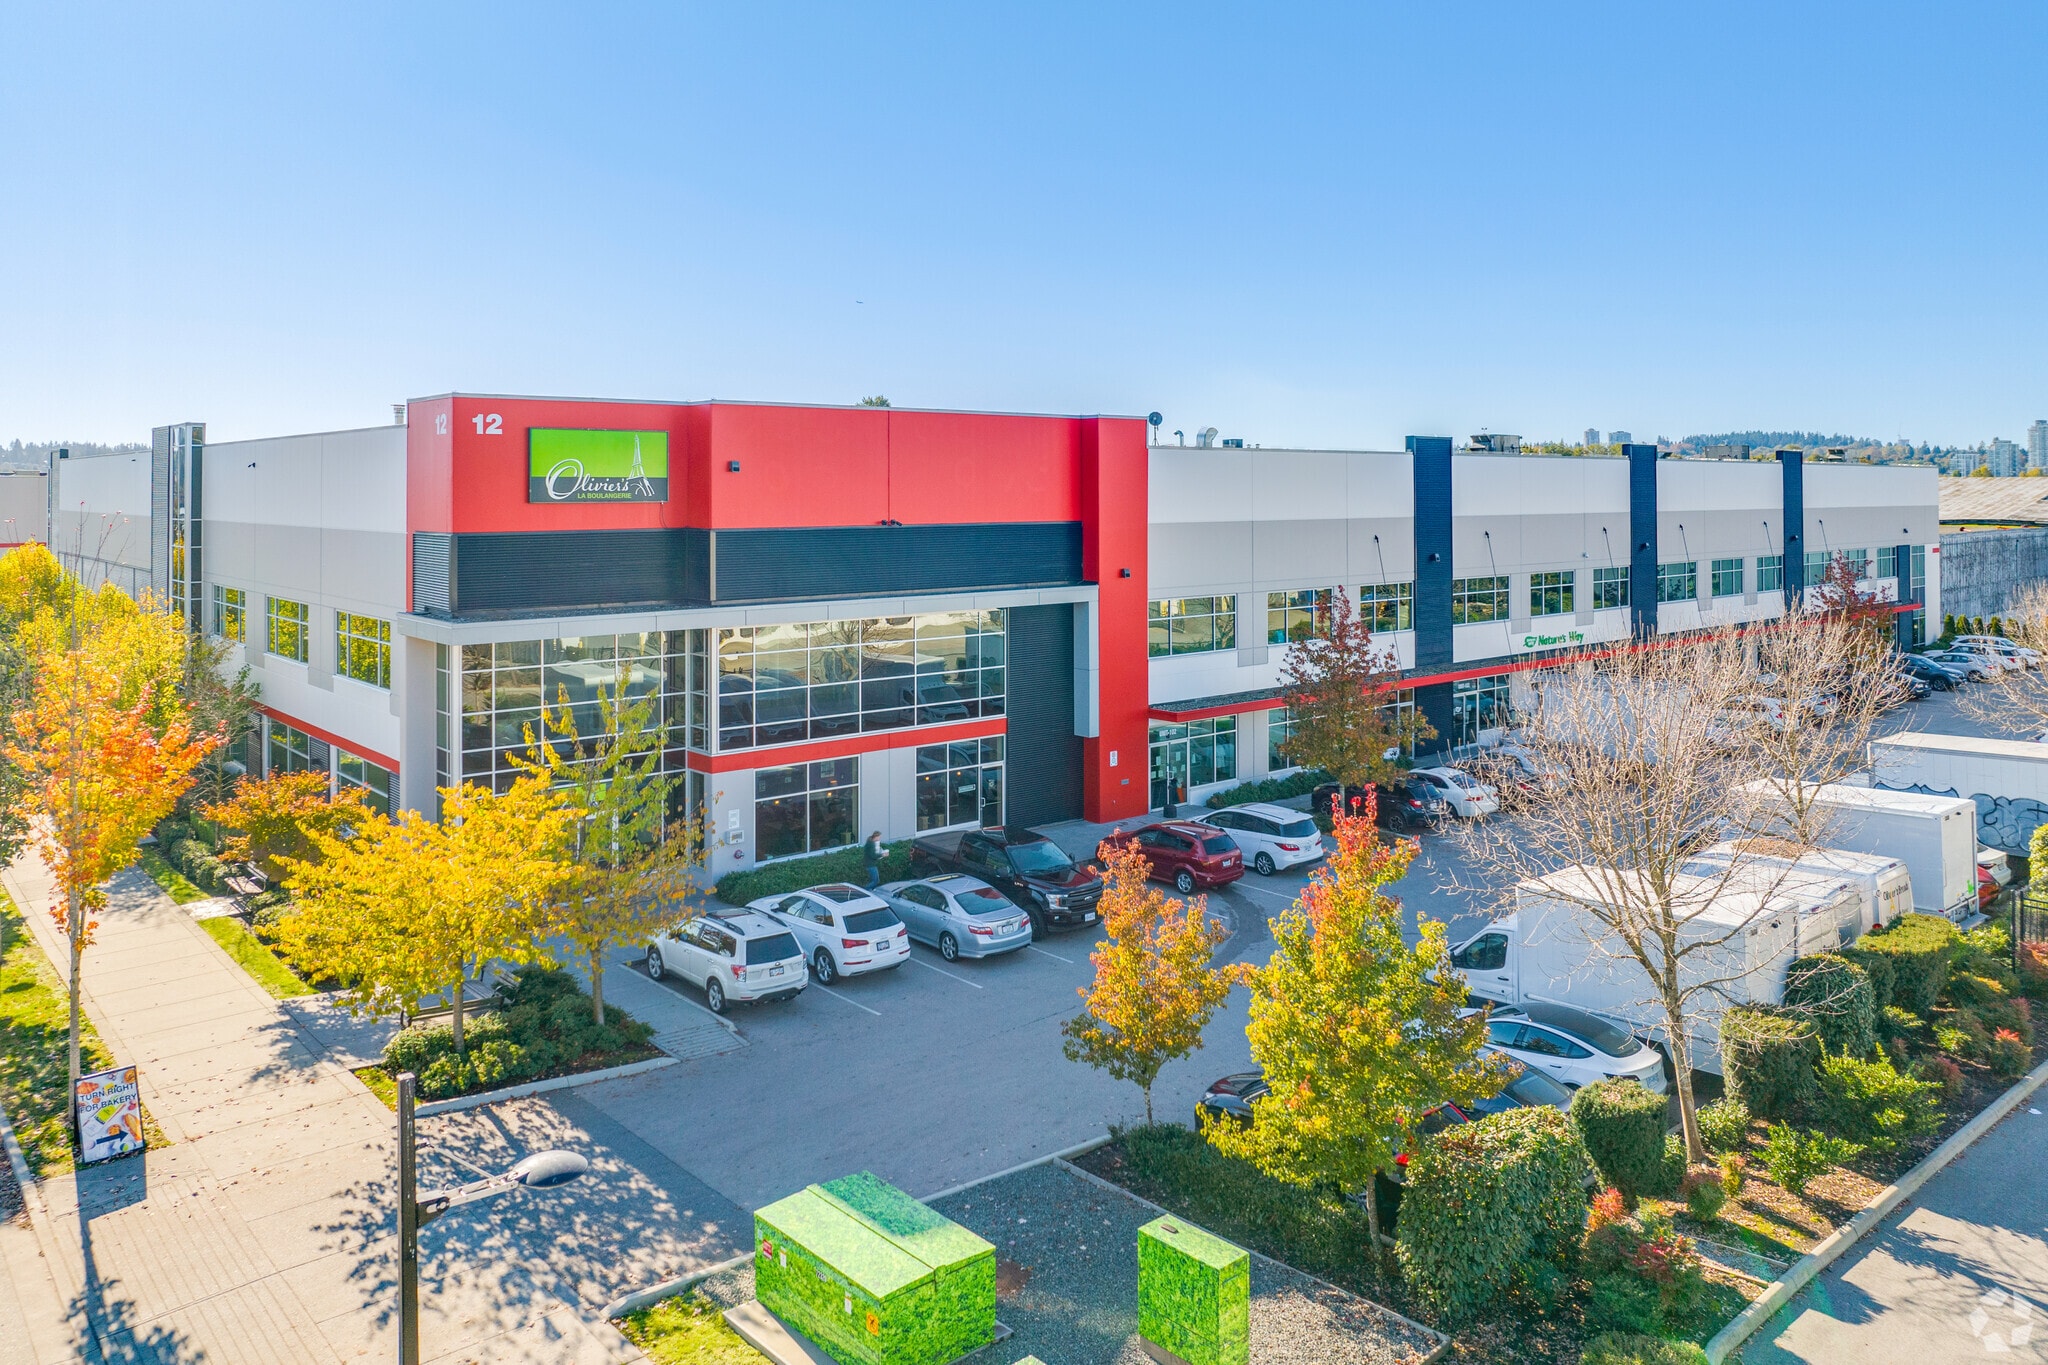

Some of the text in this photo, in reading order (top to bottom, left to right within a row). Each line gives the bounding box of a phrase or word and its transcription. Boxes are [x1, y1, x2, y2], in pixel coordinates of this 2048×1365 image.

[435, 413, 447, 434] 12
[472, 414, 503, 434] 12
[545, 458, 629, 500] Olivier's
[1538, 634, 1566, 646] Nature's
[80, 1083, 134, 1101] TURN RIGHT
[80, 1093, 137, 1113] FOR BAKERY
